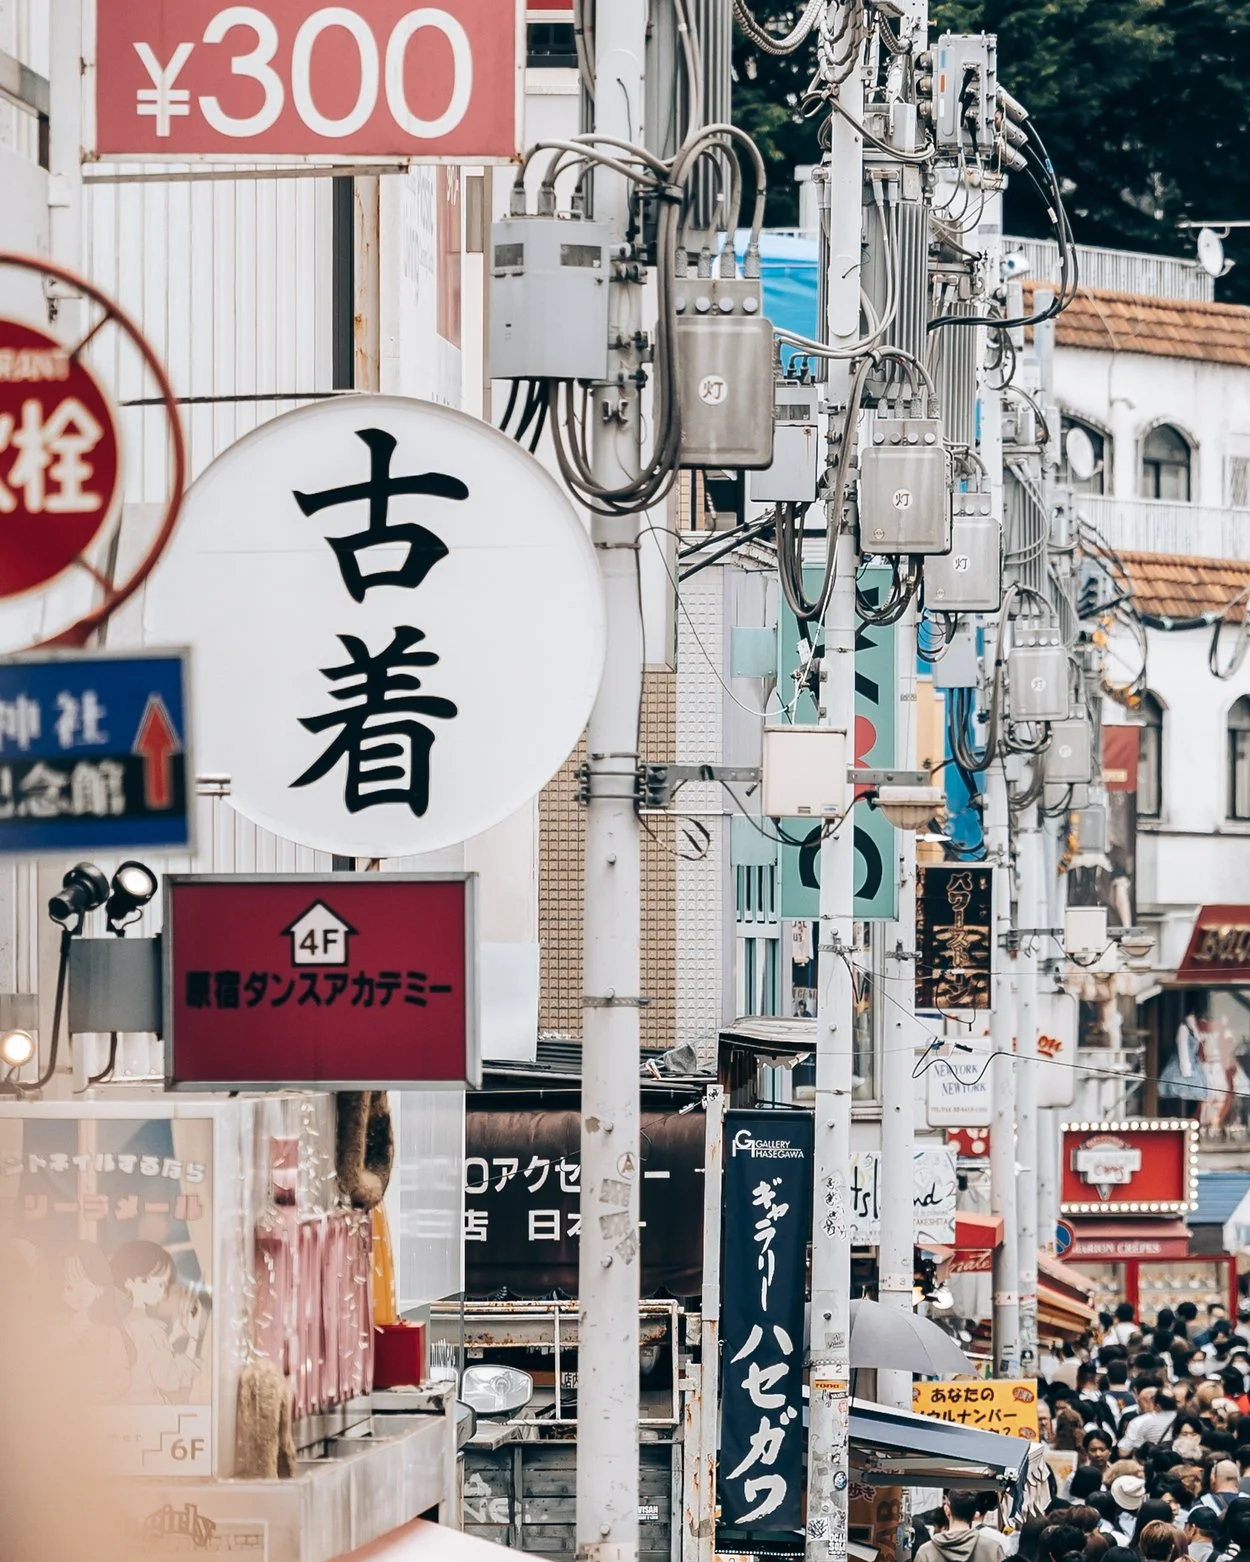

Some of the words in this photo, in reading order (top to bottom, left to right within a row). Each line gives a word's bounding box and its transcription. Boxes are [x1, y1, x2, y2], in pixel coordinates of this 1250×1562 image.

[133, 7, 473, 139] ¥300
[291, 427, 469, 817] 古着
[299, 929, 338, 955] 4F
[755, 1140, 791, 1149] GALLERY
[755, 1150, 804, 1159] HASEGAWA
[752, 1177, 790, 1312] ギャラリー
[931, 1387, 995, 1403] あなたの
[726, 1324, 798, 1524] ハセガワ
[170, 1438, 205, 1461] 6F
